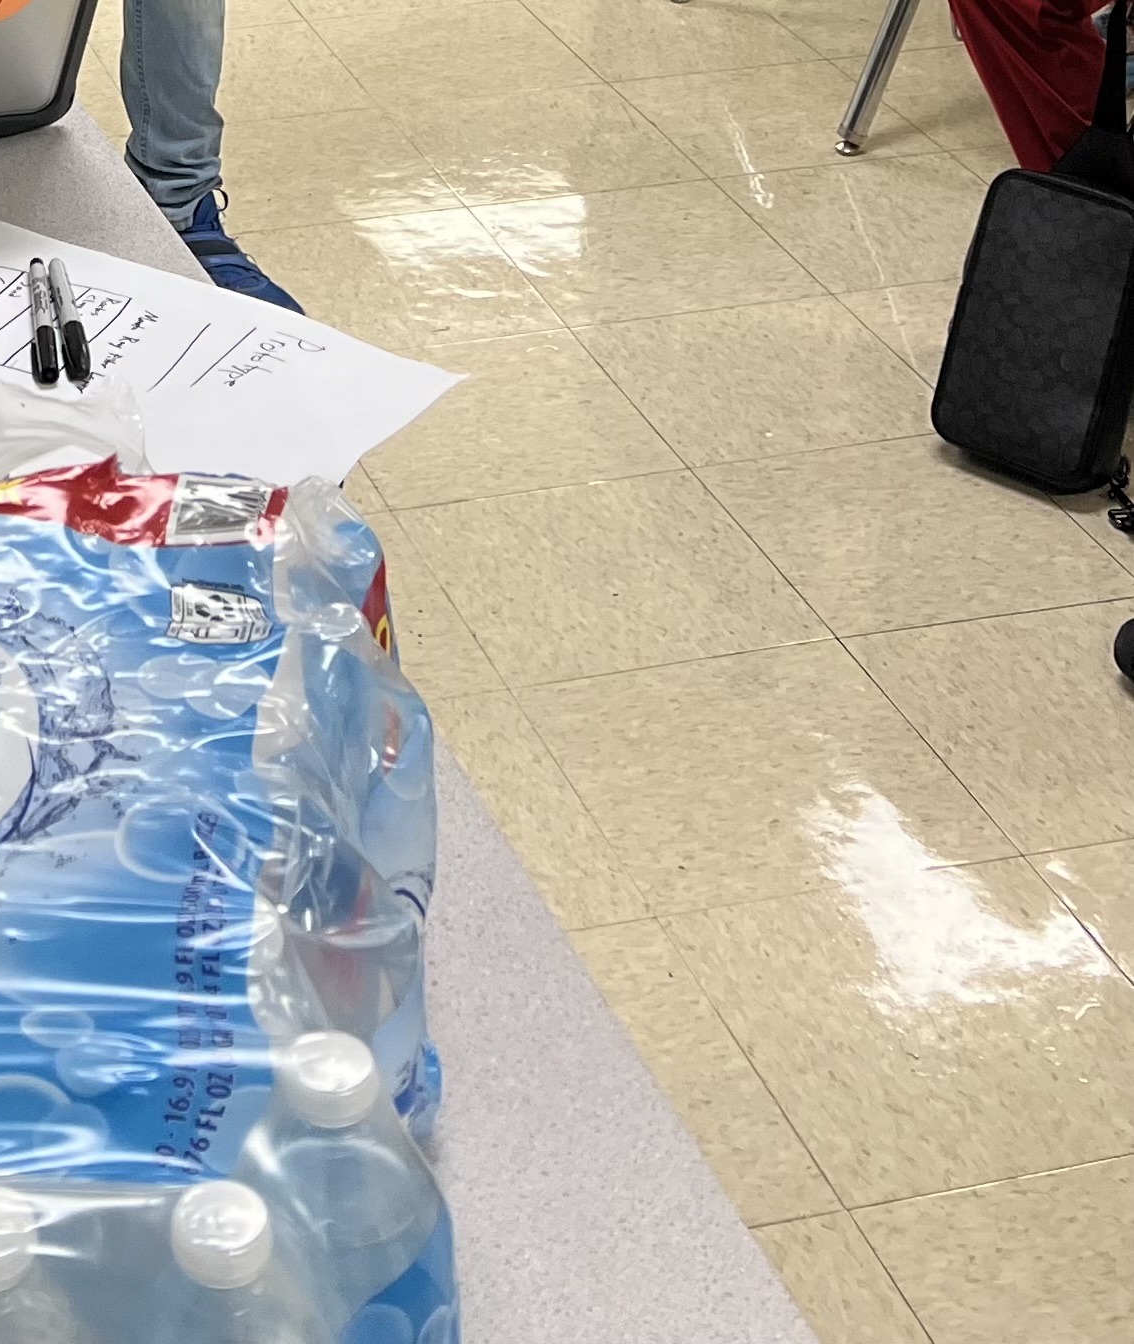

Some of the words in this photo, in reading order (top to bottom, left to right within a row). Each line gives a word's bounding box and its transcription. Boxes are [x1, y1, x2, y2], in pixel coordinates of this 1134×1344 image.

[217, 330, 326, 388] Prototype
[163, 1075, 195, 1125] 16.9
[205, 1071, 235, 1101] OZ
[194, 1105, 227, 1133] FL
